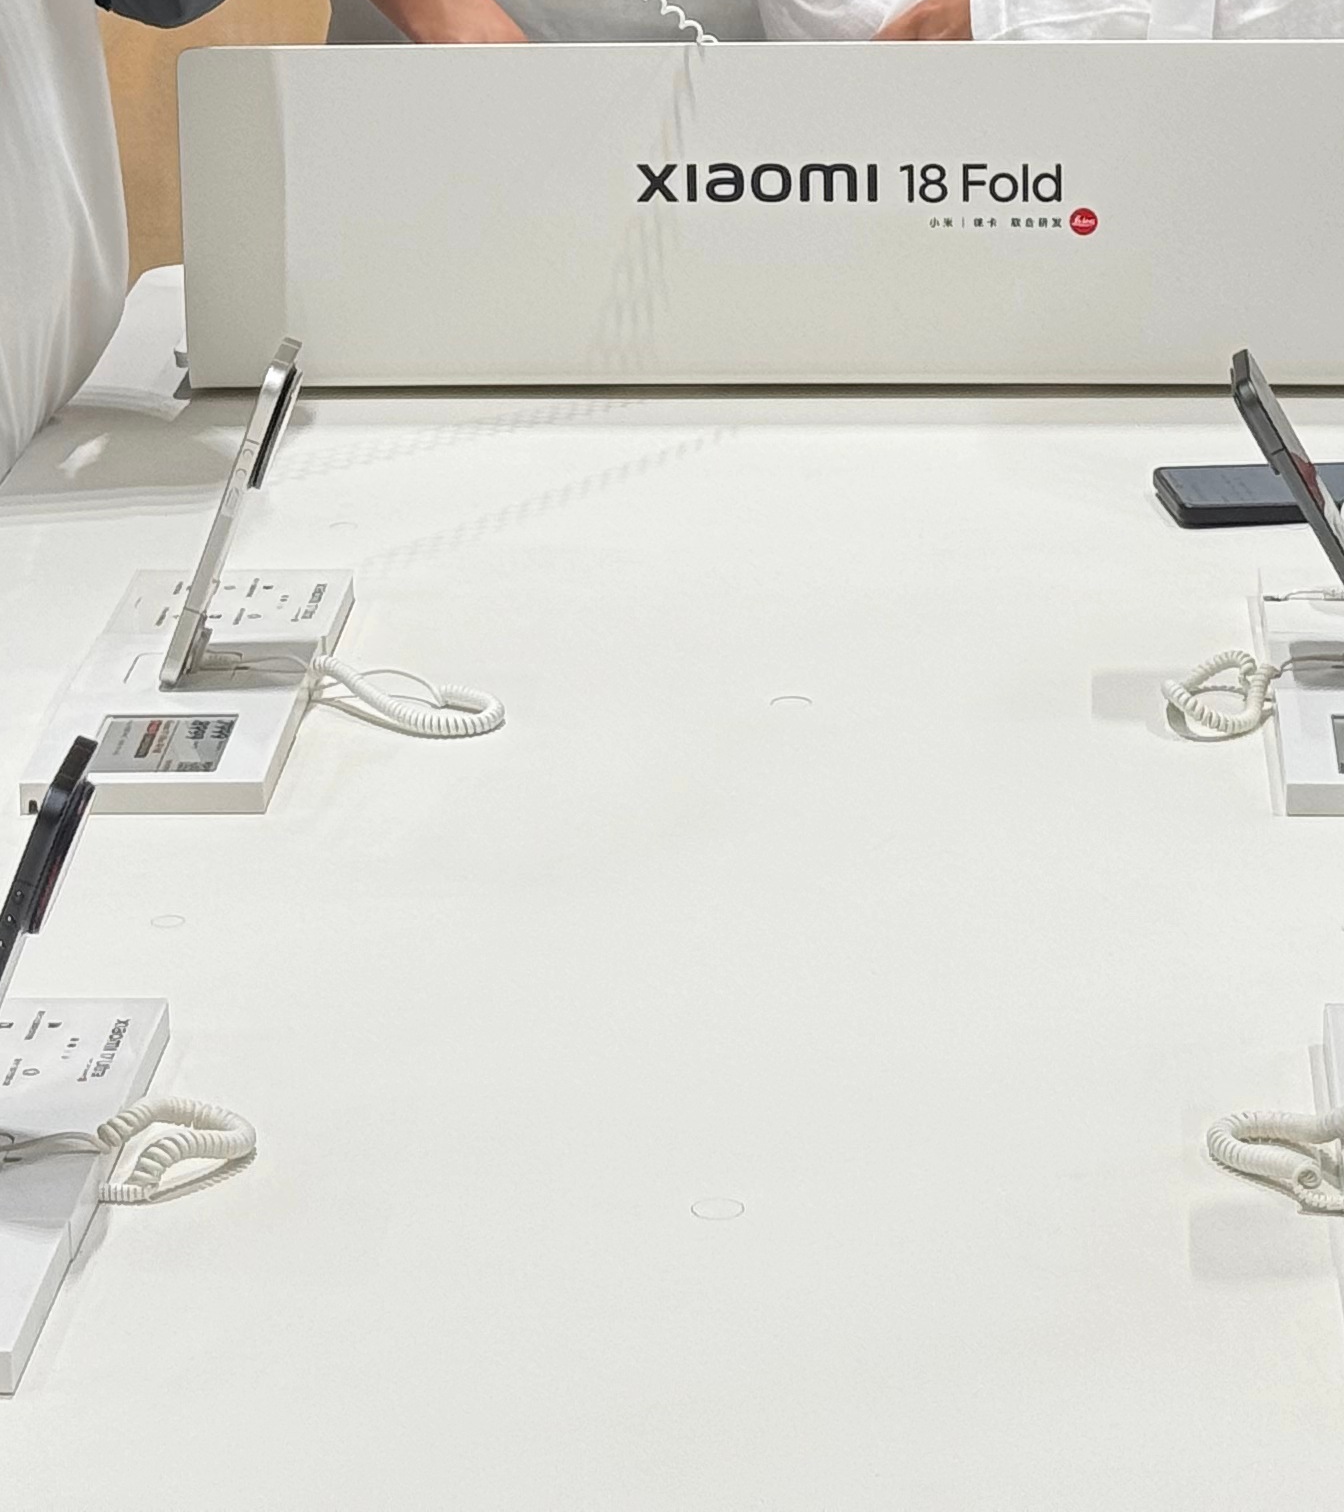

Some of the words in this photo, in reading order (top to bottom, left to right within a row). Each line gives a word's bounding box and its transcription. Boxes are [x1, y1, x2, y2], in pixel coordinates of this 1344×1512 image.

[636, 163, 878, 203] xiaomi
[899, 163, 948, 203] 18
[961, 163, 1062, 203] Fold
